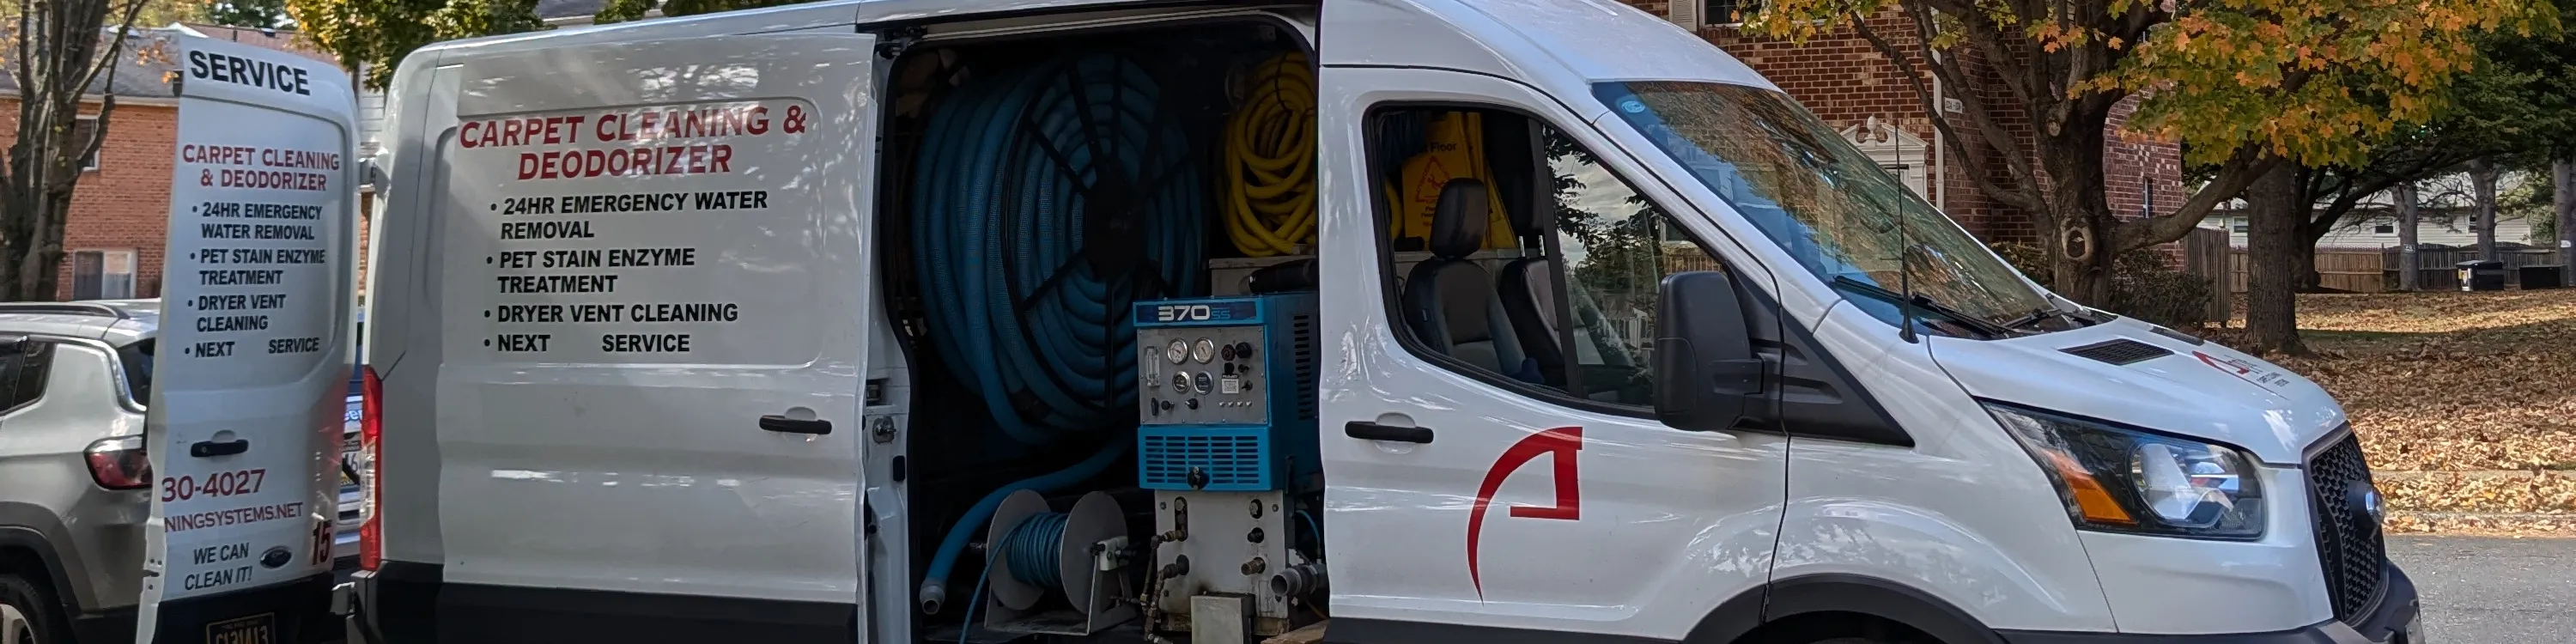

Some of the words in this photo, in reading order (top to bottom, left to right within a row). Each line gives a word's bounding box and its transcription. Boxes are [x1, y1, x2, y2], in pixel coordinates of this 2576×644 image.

[189, 50, 311, 96] SERVICE
[460, 114, 586, 149] CARPET
[596, 106, 769, 143] CLEANING
[782, 105, 807, 134] &
[183, 144, 256, 166] CARPET
[262, 149, 340, 170] CLEANING
[518, 144, 732, 180] DEODORIZER
[200, 168, 213, 186] &
[221, 169, 326, 191] DEODORIZER
[203, 202, 240, 217] 24HR
[245, 204, 323, 220] EMERGENCY
[503, 197, 555, 216] 24HR
[561, 193, 689, 214] EMERGENCY
[695, 191, 768, 210] WATER
[201, 223, 251, 239] WATER
[254, 224, 314, 240] REMOVAL
[500, 220, 595, 240] REMOVAL
[200, 248, 229, 264] PET
[232, 249, 273, 264] STAIN
[276, 249, 325, 264] ENZYME
[500, 251, 538, 269] PET
[543, 250, 601, 268] STAIN
[608, 248, 696, 267] ENZYME
[199, 270, 283, 285] TREATMENT
[497, 275, 618, 294] TREATMENT
[197, 295, 246, 311] DRYER
[250, 294, 287, 310] VENT
[498, 305, 564, 323] DRYER
[570, 304, 625, 322] VENT
[630, 303, 738, 322] CLEANING
[197, 315, 268, 332] CLEANING
[195, 341, 235, 358] NEXT
[268, 337, 320, 355] SERVICE
[497, 334, 551, 352] NEXT
[602, 334, 690, 353] SERVICE
[161, 469, 266, 502] 30-4027
[164, 502, 303, 532] NINGSYSTEMS.NET
[313, 519, 332, 565] 15
[193, 546, 217, 565] WE
[220, 543, 249, 560] CAN
[185, 569, 233, 591] CLEAN
[235, 566, 252, 583] IT!
